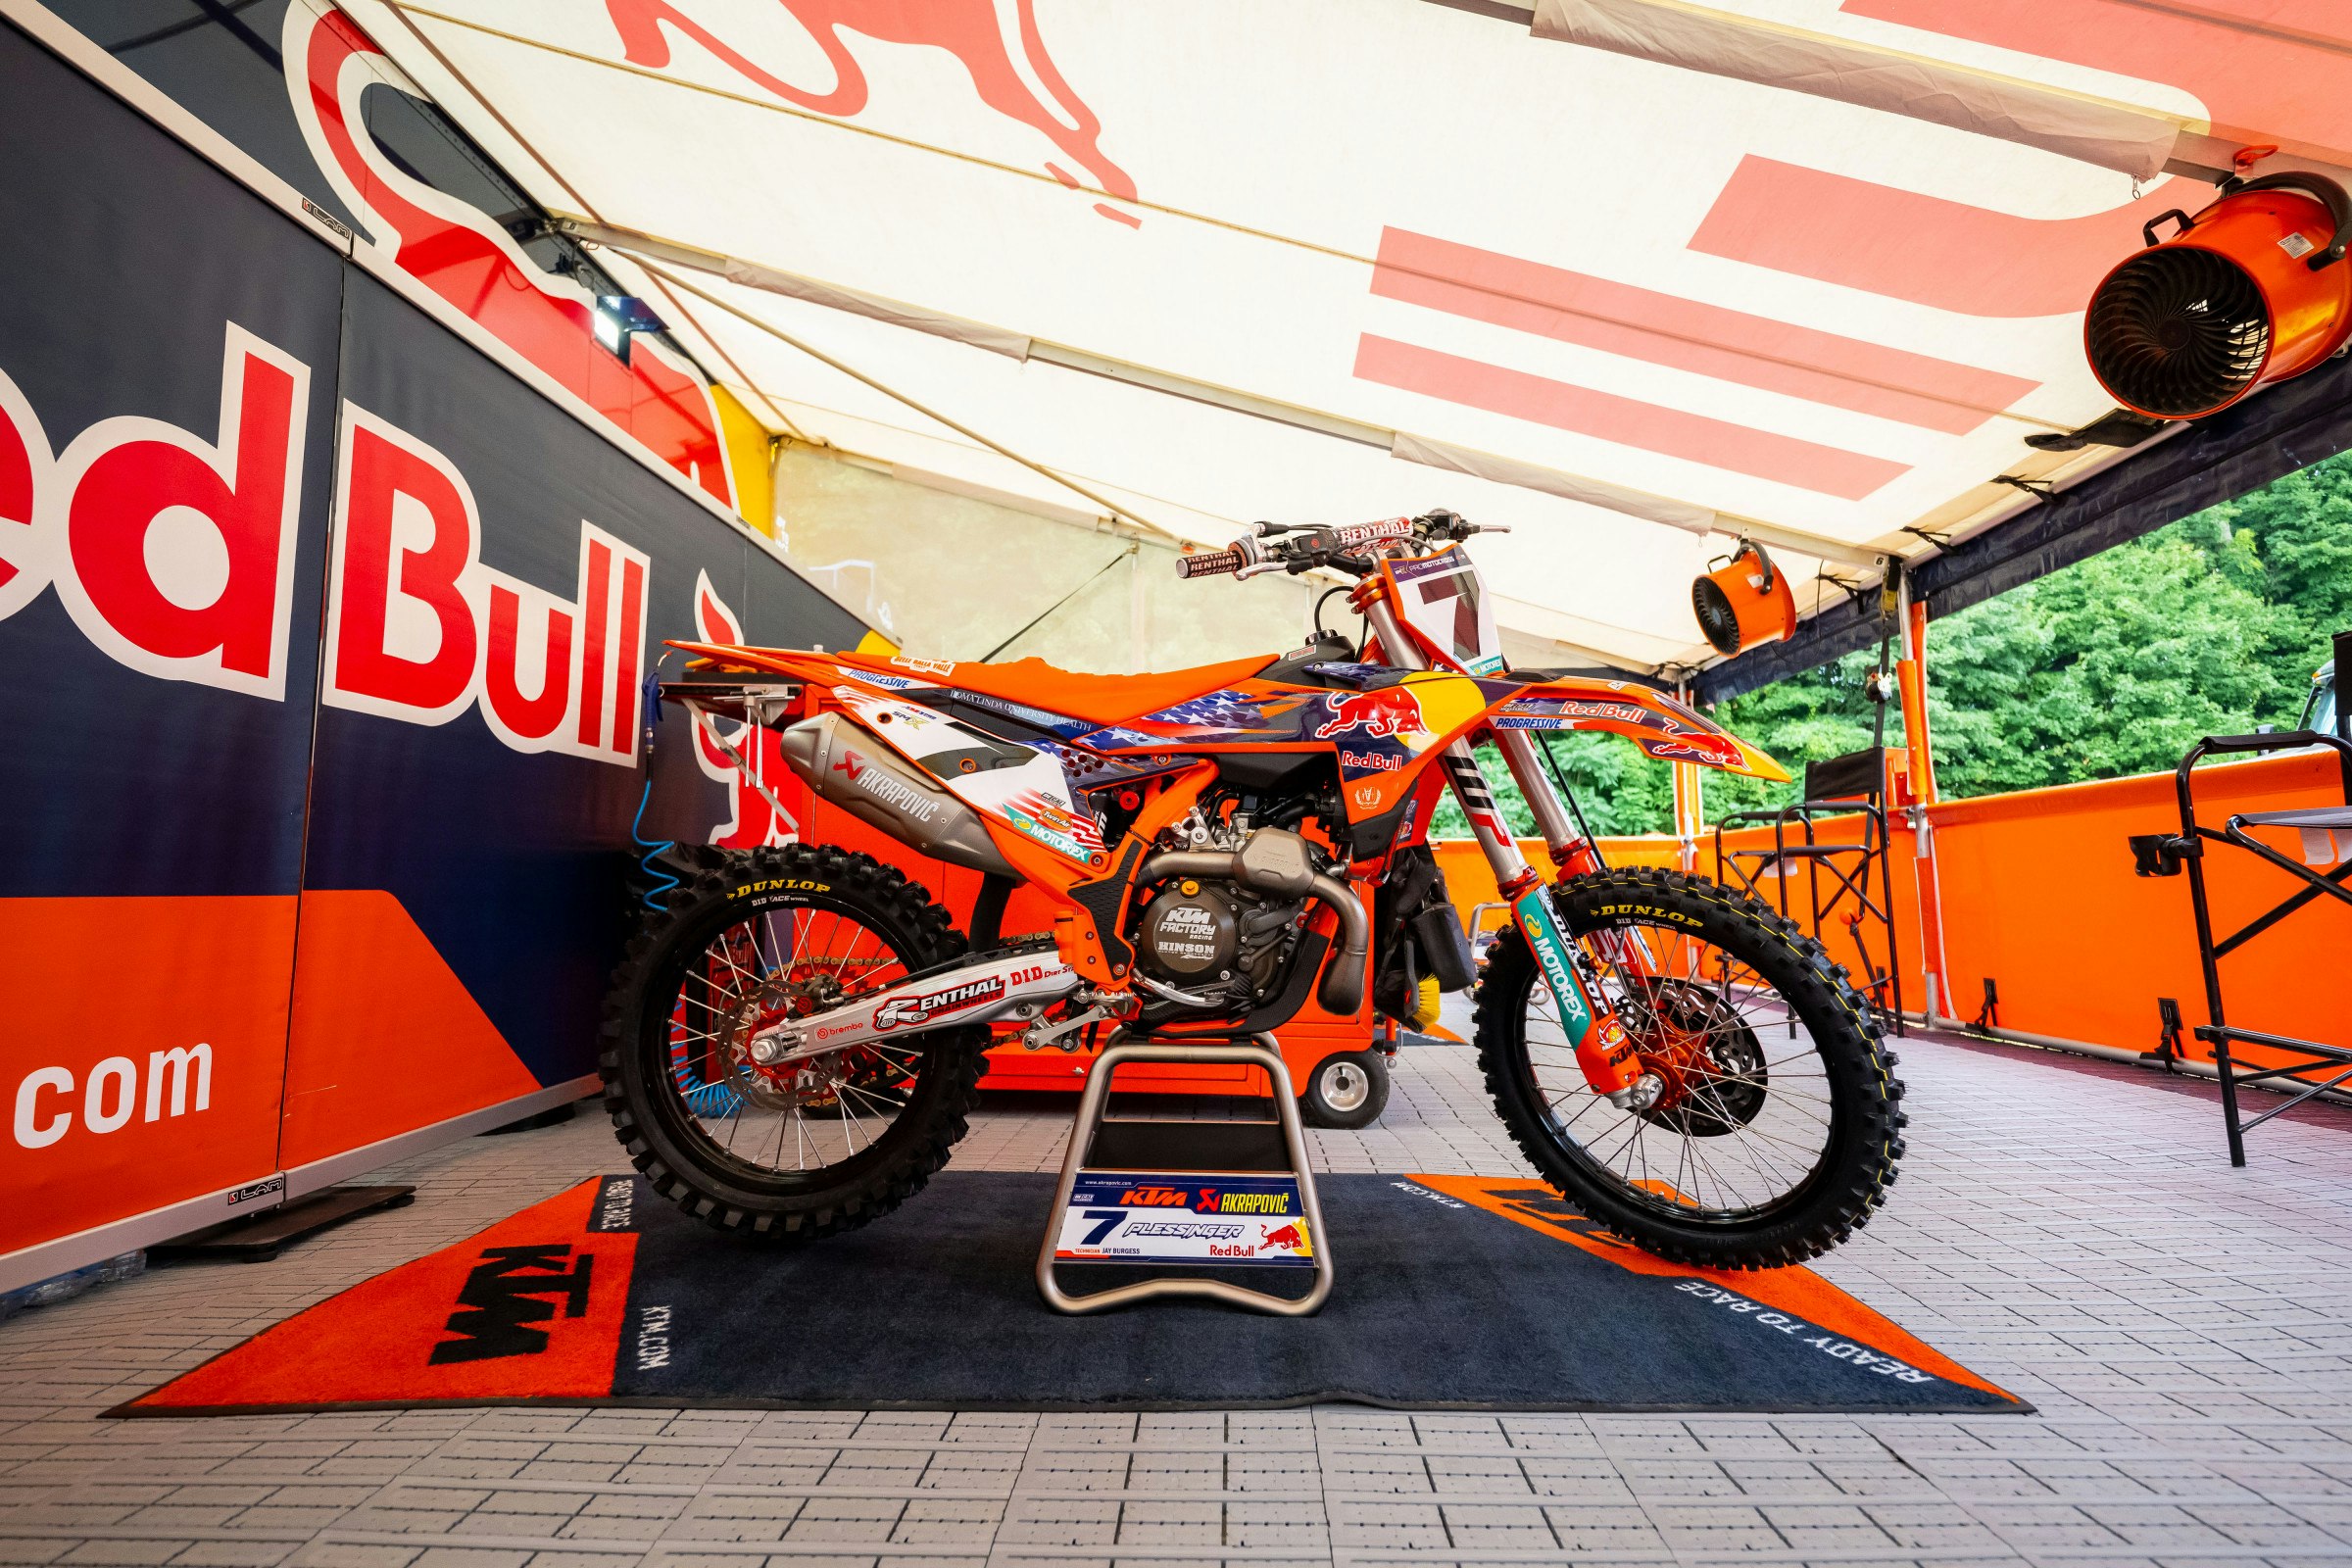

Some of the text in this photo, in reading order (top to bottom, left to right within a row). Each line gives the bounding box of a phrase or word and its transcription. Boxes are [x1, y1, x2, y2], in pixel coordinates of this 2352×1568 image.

[1341, 520, 1409, 545] RENTHAL
[0, 320, 651, 768] d Bull
[1188, 551, 1236, 564] RENTHAL
[1191, 556, 1239, 571] RENTHAL
[1876, 557, 1884, 565] 6
[1191, 564, 1238, 577] RENTHAL
[1418, 570, 1481, 662] 7
[850, 669, 910, 689] PROGRESSIVE
[976, 695, 1004, 710] LINDA
[1004, 701, 1055, 724] UNIVERSITY
[1055, 714, 1092, 732] HEALTH
[1495, 716, 1563, 729] PROGRESSIVE
[1558, 701, 1647, 723] Red Bull
[1342, 751, 1401, 771] Red Bull
[858, 767, 941, 822] AKRAPOVIČ
[1043, 810, 1060, 823] Twin
[1029, 822, 1090, 861] MOTOREX
[736, 879, 831, 897] DUNLOP
[1166, 907, 1211, 924] KTM
[1600, 904, 1703, 928] DUNLOP
[1159, 922, 1216, 935] FACTORY
[1158, 942, 1215, 954] HINSON
[1535, 937, 1587, 1022] MOTOREX
[931, 991, 1002, 1015] CHAINWHEELS
[829, 1022, 863, 1037] brembo
[1119, 1187, 1188, 1206] KTM
[1221, 1193, 1289, 1213] AKRAPOVIČ
[1080, 1210, 1128, 1245] 7
[1122, 1222, 1246, 1239] PLESSINGER
[1209, 1245, 1254, 1257] Red Bull
[430, 1243, 592, 1366] KTM
[637, 1304, 672, 1371] KTM.COM
[1674, 1281, 1936, 1384] READY TO RACE
